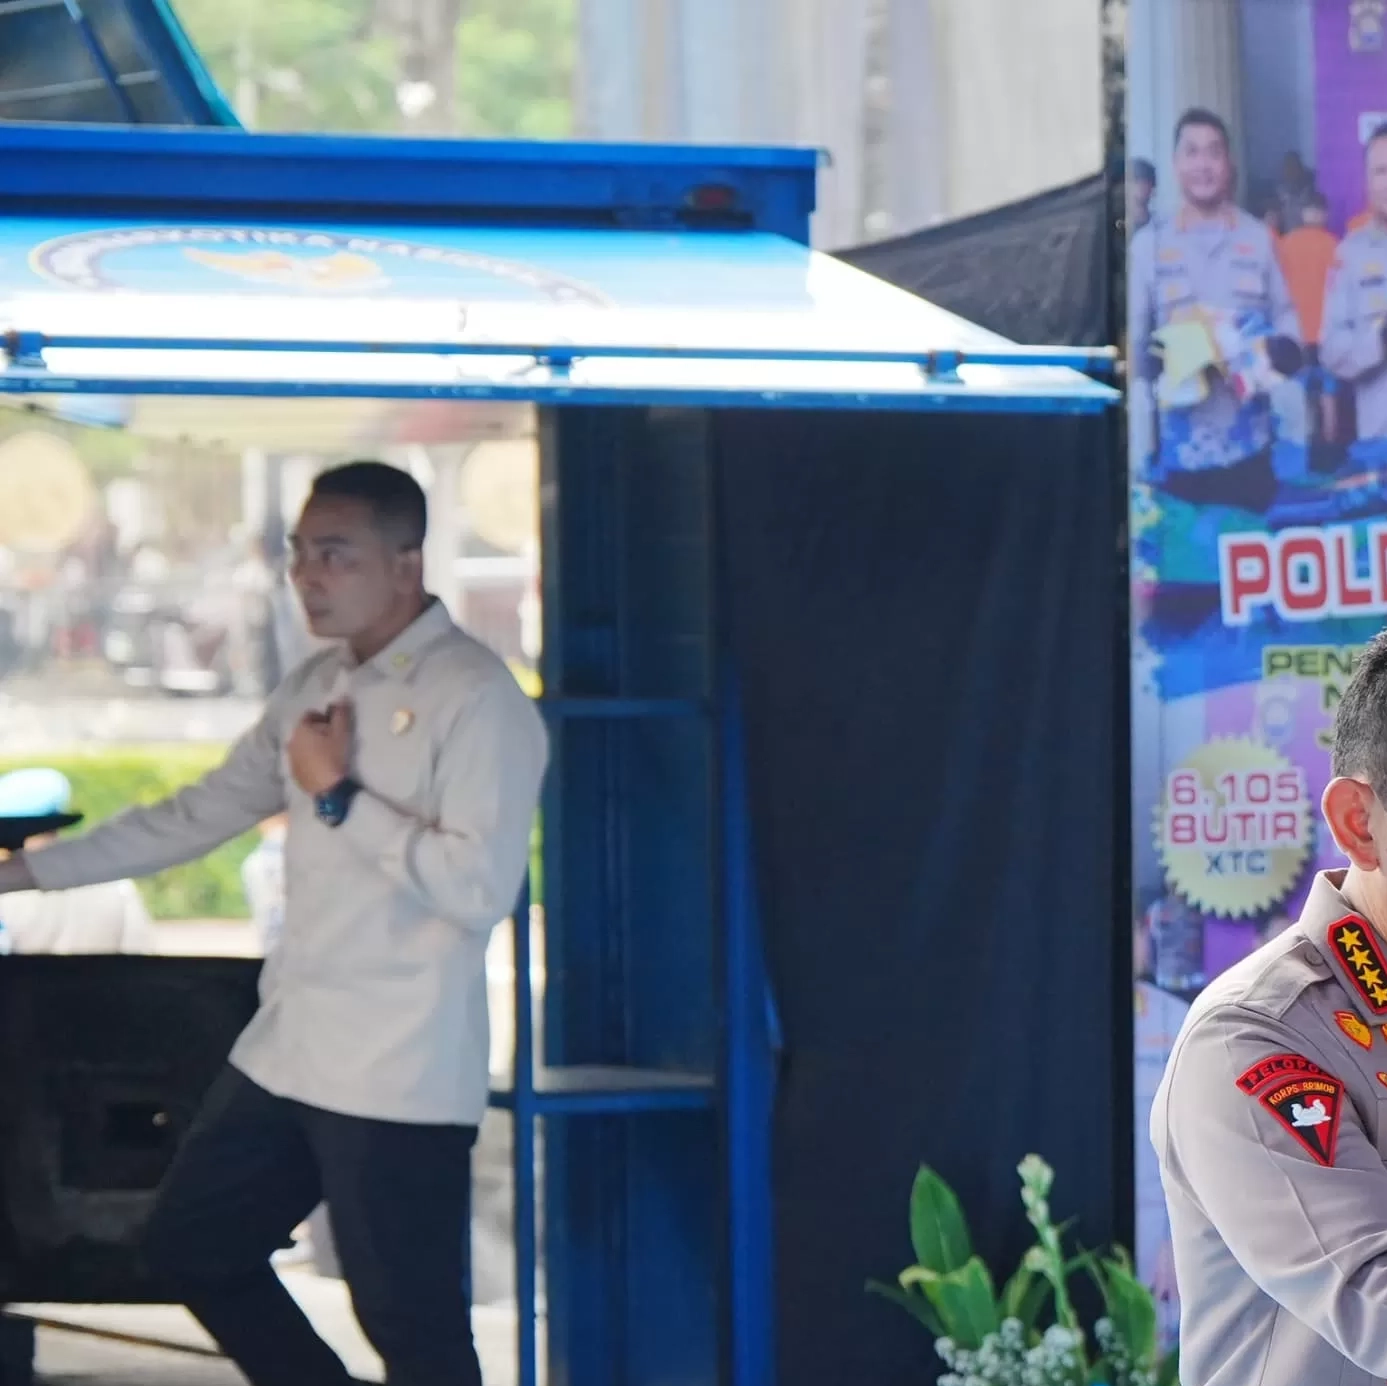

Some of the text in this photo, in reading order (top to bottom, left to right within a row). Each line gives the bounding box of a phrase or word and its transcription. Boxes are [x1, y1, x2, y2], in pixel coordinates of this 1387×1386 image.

[1172, 772, 1299, 805] 6.105
[1170, 811, 1298, 844] BUTIR
[1206, 850, 1267, 876] XTC
[1267, 1081, 1336, 1106] KORPS BRIMOB
